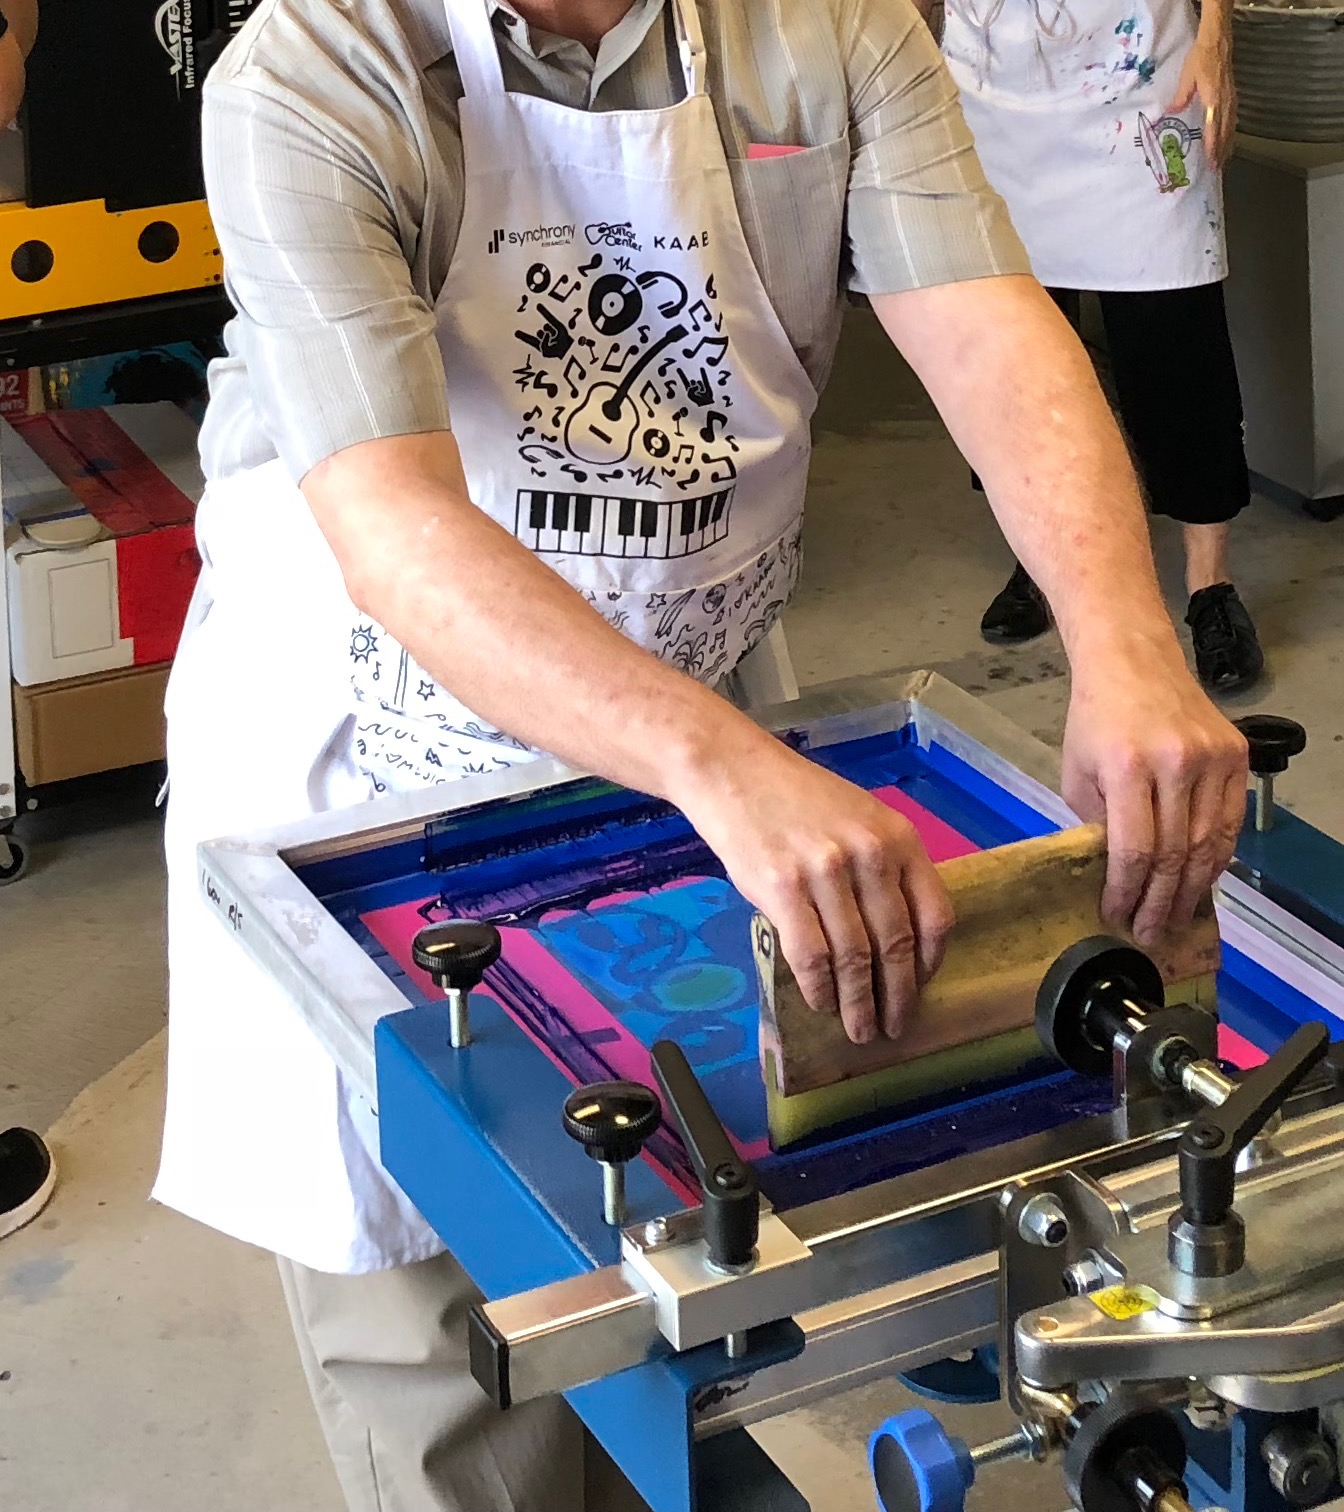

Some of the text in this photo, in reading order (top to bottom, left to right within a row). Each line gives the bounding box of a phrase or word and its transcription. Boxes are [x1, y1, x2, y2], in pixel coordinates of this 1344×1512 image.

[183, 37, 195, 89] Infrared
[508, 224, 576, 248] synchrony
[604, 234, 642, 252] Center
